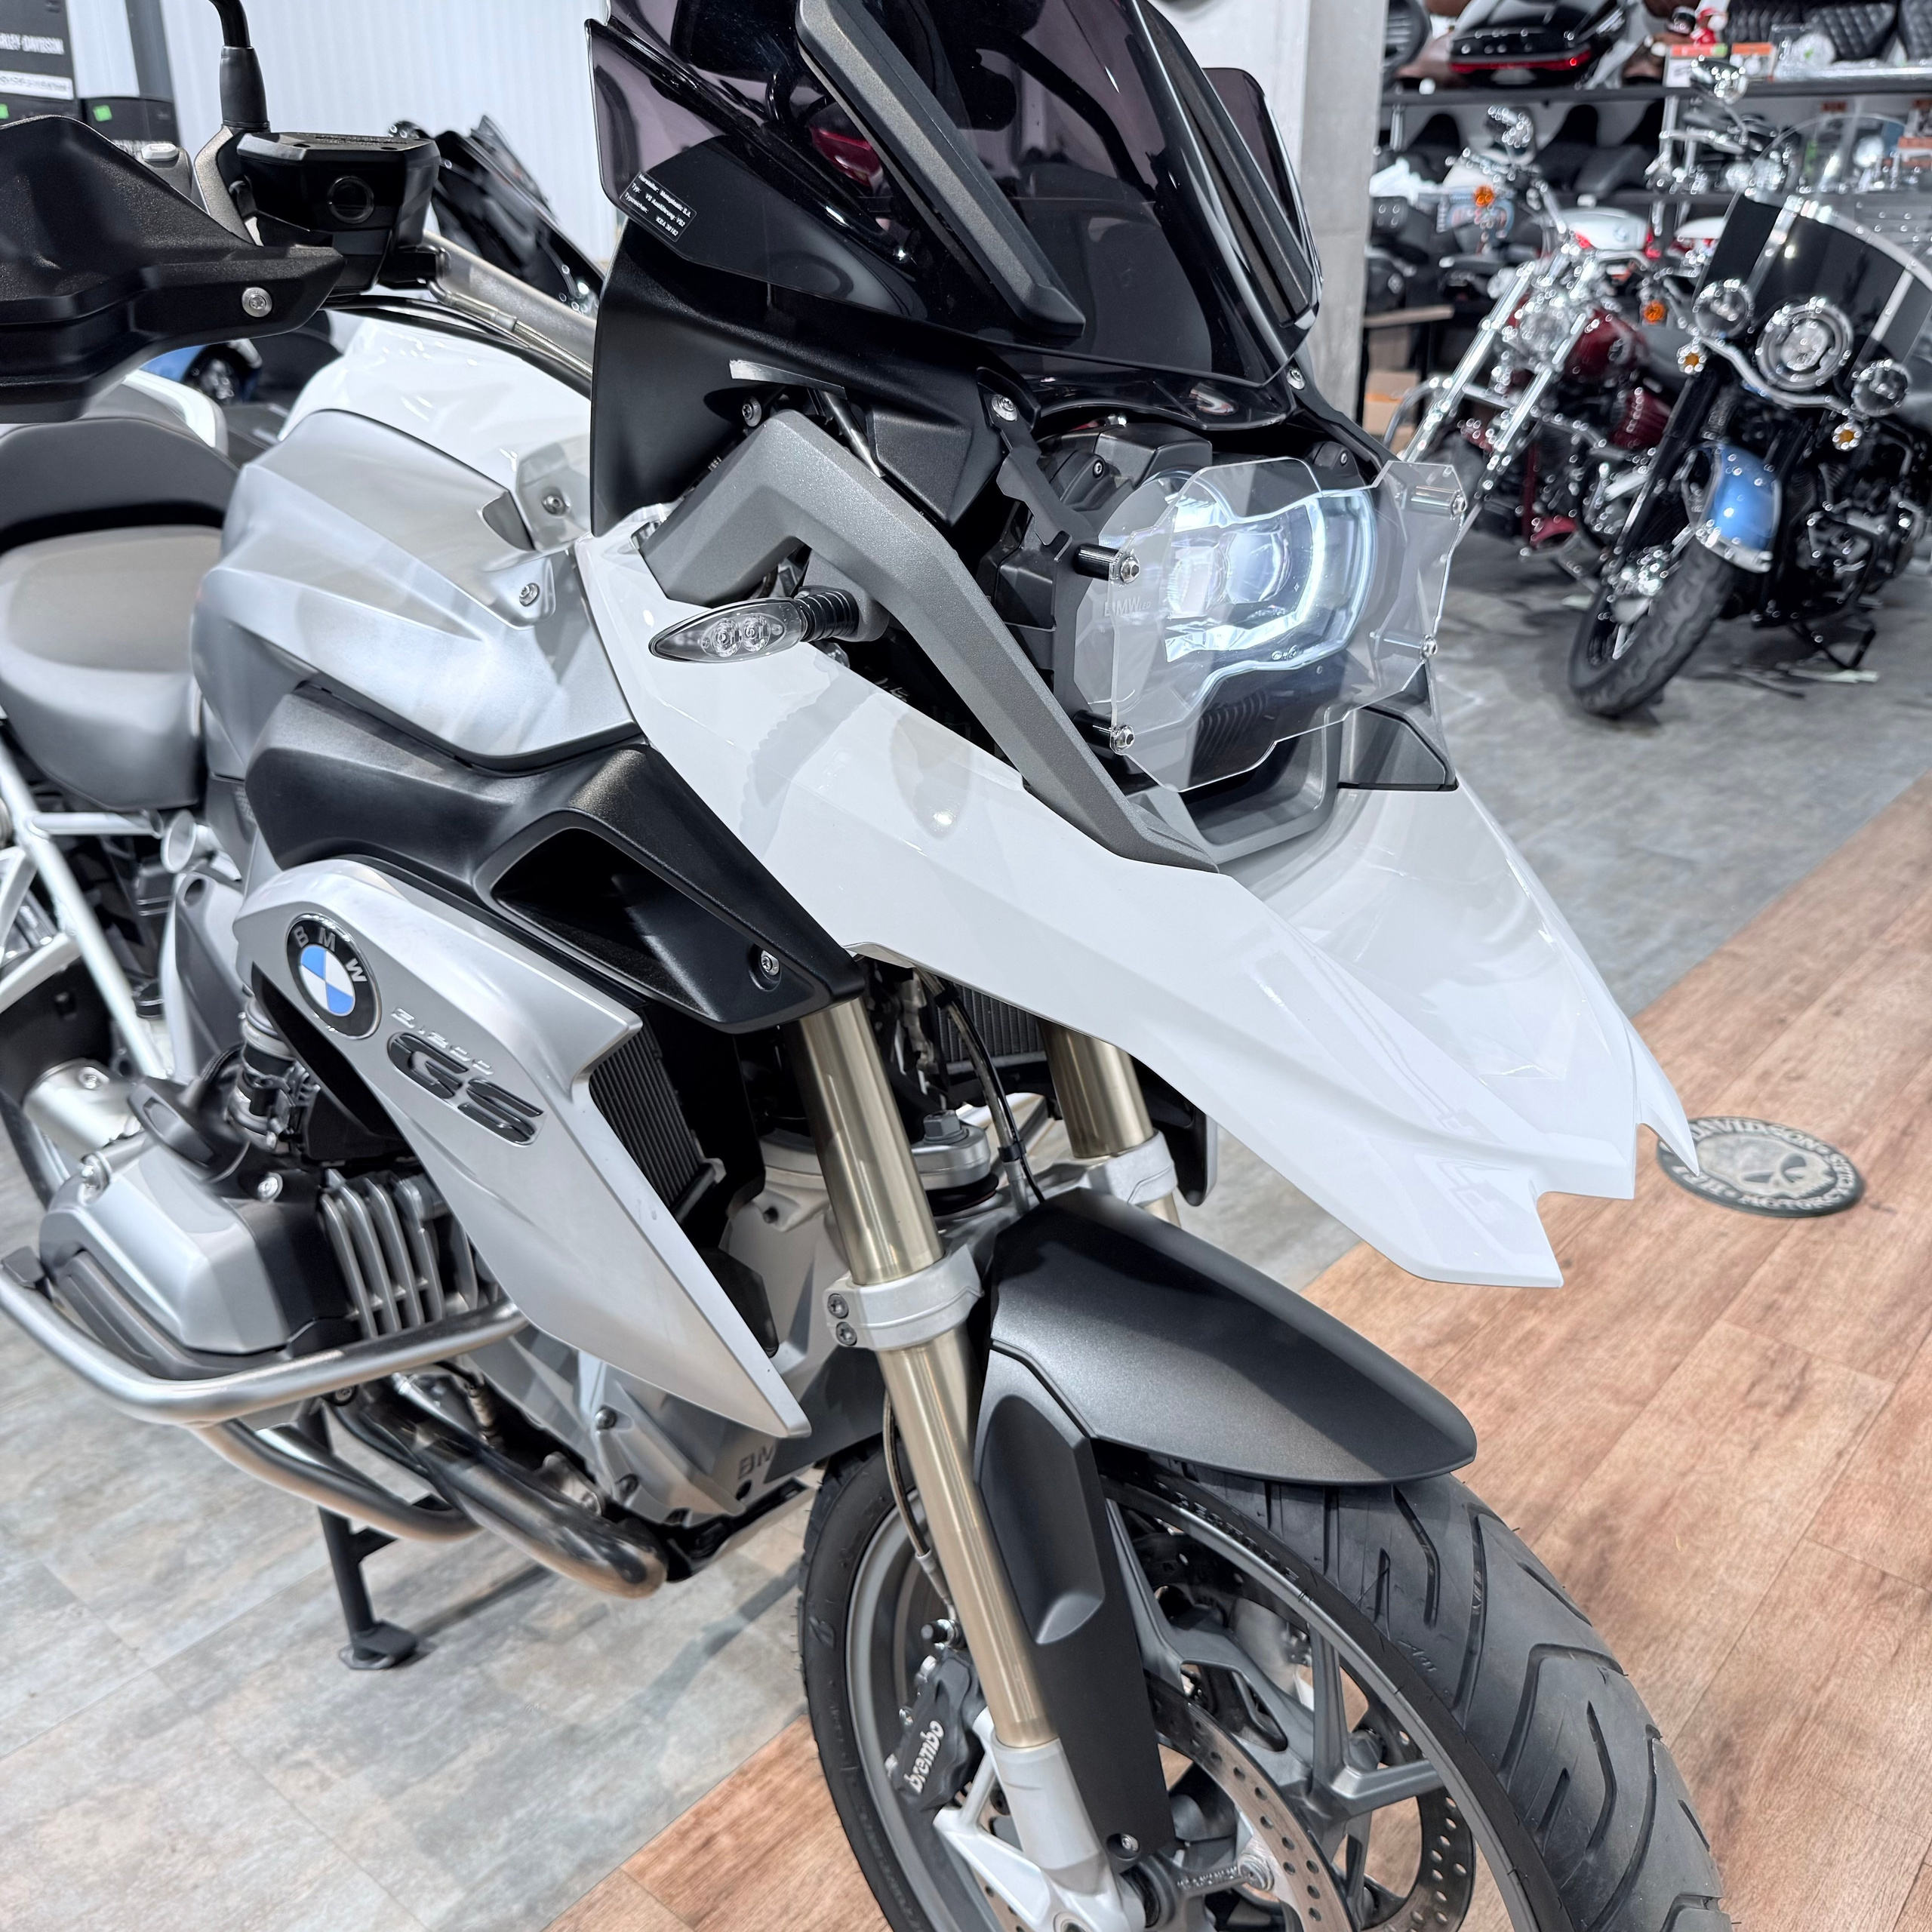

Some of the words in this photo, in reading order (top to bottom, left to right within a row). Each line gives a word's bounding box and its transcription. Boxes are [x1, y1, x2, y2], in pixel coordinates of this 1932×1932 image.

[632, 183, 641, 194] Typ:
[294, 925, 368, 982] BMW
[387, 1031, 544, 1146] GS
[738, 1444, 774, 1480] BM
[903, 1720, 944, 1794] brembo
